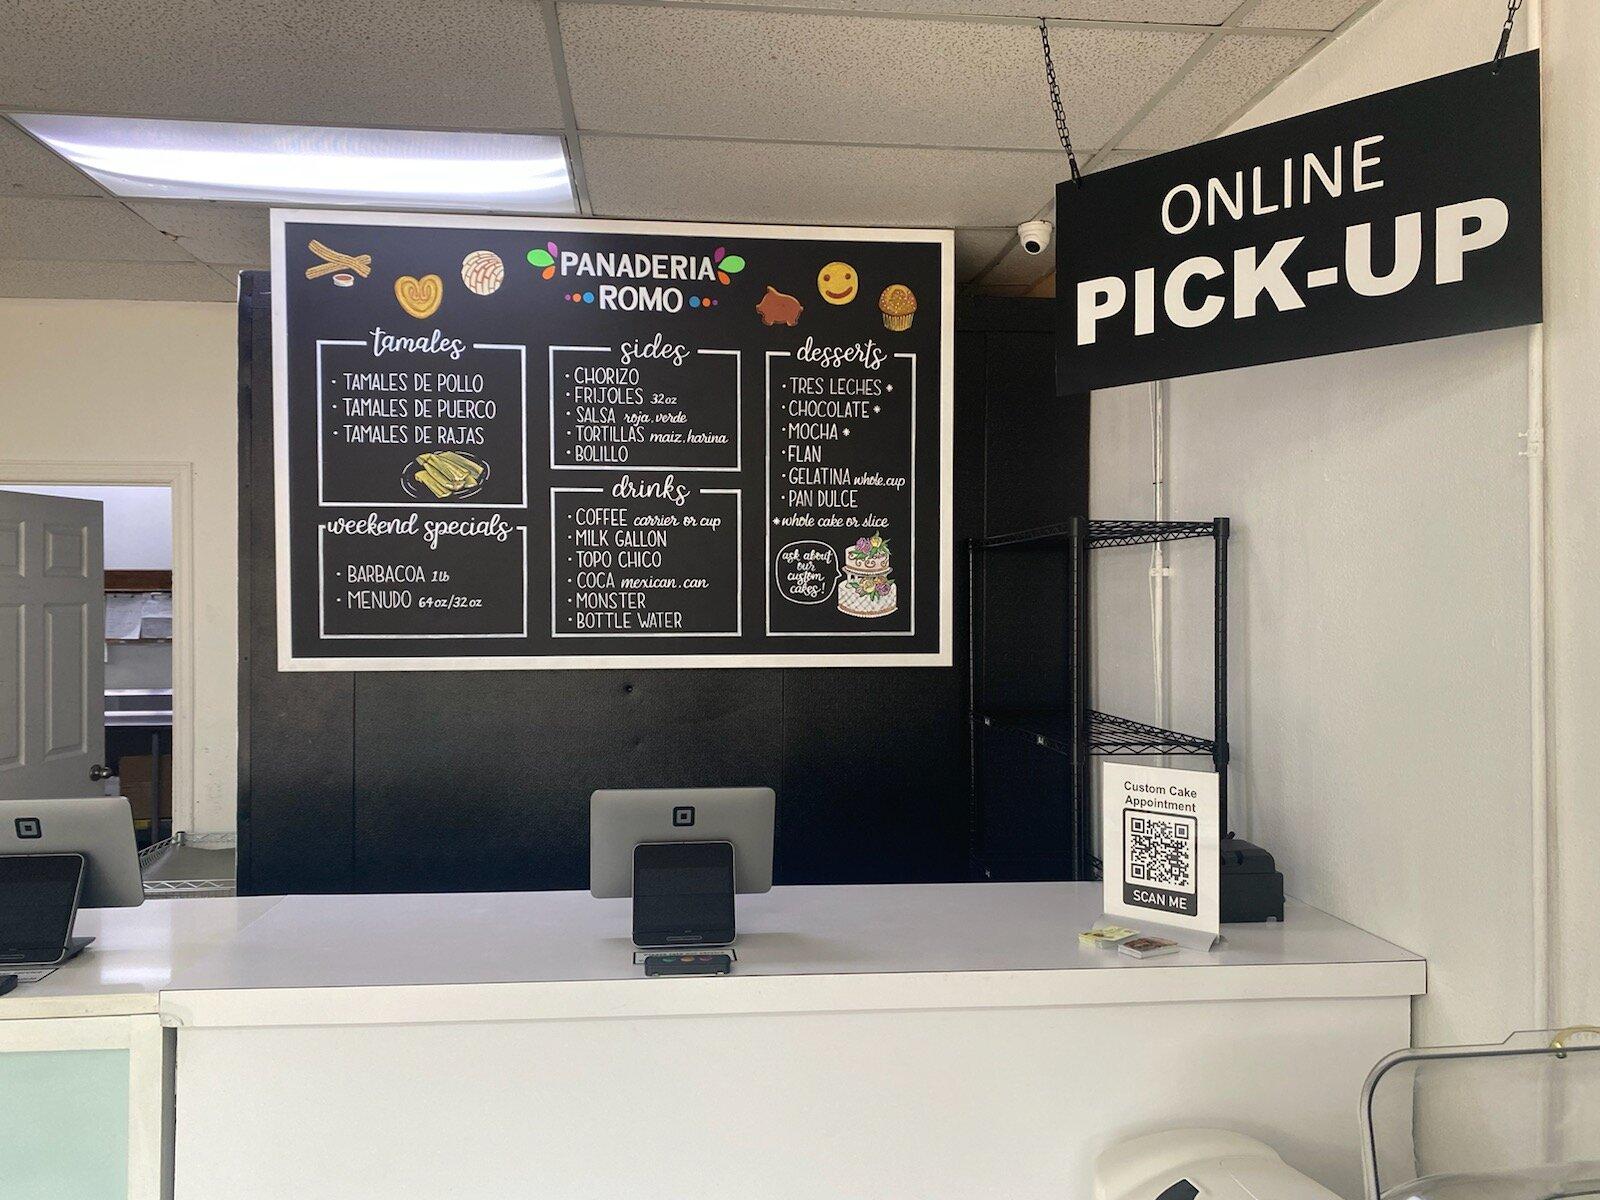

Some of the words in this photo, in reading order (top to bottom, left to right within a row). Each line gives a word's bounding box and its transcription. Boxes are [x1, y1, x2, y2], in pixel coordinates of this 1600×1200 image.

[1161, 134, 1385, 235] ONLINE
[560, 251, 716, 281] PANADERIA
[1076, 197, 1509, 346] PICK-UP
[599, 284, 684, 313] ROMO
[369, 327, 466, 360] tamales
[620, 332, 690, 366] sides
[797, 336, 888, 370] desserts
[343, 372, 408, 391] TAMALES
[414, 373, 432, 391] DE
[438, 374, 484, 393] POLLO
[574, 366, 640, 385] CHORIZO
[574, 386, 643, 405] FRIJOLES
[649, 393, 678, 405] 32oz
[789, 377, 824, 395] TRES
[829, 378, 882, 396] LECHES
[342, 398, 408, 418] TAMALES
[414, 399, 432, 418] DE
[438, 399, 496, 419] PUERCO
[576, 406, 616, 424] SALSA
[788, 400, 870, 418] CHOCOLATE
[343, 424, 408, 444] TAMALES
[414, 425, 432, 444] DE
[438, 426, 484, 445] RAJAS
[575, 425, 645, 443] TORTILLAS
[788, 422, 838, 440] MOCHA
[575, 445, 628, 463] BOLILLO
[788, 445, 822, 463] FLAN
[788, 467, 851, 485] GELATINA
[612, 474, 690, 506] drinks
[788, 490, 813, 508] PAN
[818, 490, 858, 508] DULCE
[575, 508, 628, 527] COFFEE
[633, 515, 680, 527] carrier
[683, 517, 698, 527] or
[699, 517, 721, 532] cup
[817, 513, 844, 528] cake
[846, 518, 860, 528] or
[862, 513, 889, 528] slice
[326, 512, 419, 536] weekend
[423, 513, 513, 550] specials
[575, 529, 609, 547] MILK
[615, 530, 667, 547] GALLON
[576, 551, 612, 568] TOPO
[618, 551, 662, 568] CHICO
[781, 549, 800, 563] ask
[803, 549, 834, 563] about
[347, 565, 426, 583] BARBACOA
[431, 570, 450, 582] 1lb
[797, 561, 816, 571] our
[576, 572, 616, 589] COCA
[787, 572, 825, 586] custom
[789, 582, 826, 598] cakes!
[347, 590, 412, 609] MENUDO
[576, 592, 646, 609] MONSTER
[576, 612, 632, 629] BOTTLE
[637, 611, 683, 629] WATER
[1124, 781, 1166, 794] Custom
[1169, 786, 1197, 798] Cake
[1125, 795, 1196, 813] Appointment
[1132, 889, 1166, 906] SCAN
[1168, 896, 1187, 910] ME
